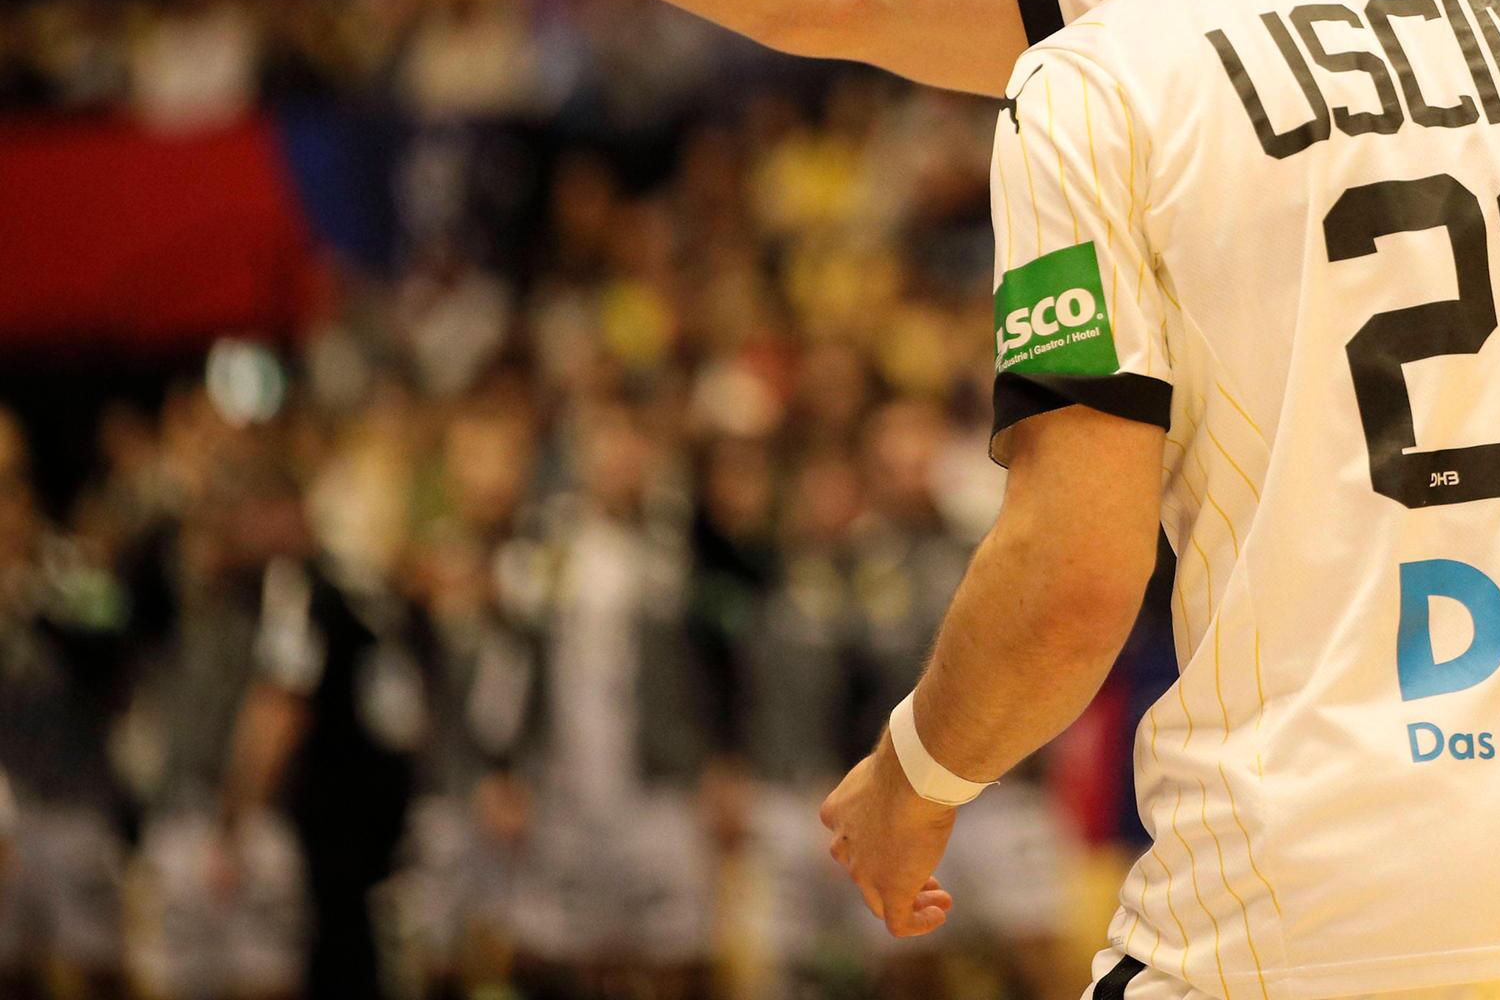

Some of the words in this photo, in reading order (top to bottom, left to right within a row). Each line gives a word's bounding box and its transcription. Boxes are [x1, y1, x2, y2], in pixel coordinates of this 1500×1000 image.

[1033, 338, 1065, 355] Gastro
[1071, 327, 1100, 342] Hotel
[1429, 470, 1459, 488] DHB
[1406, 721, 1495, 763] Das
